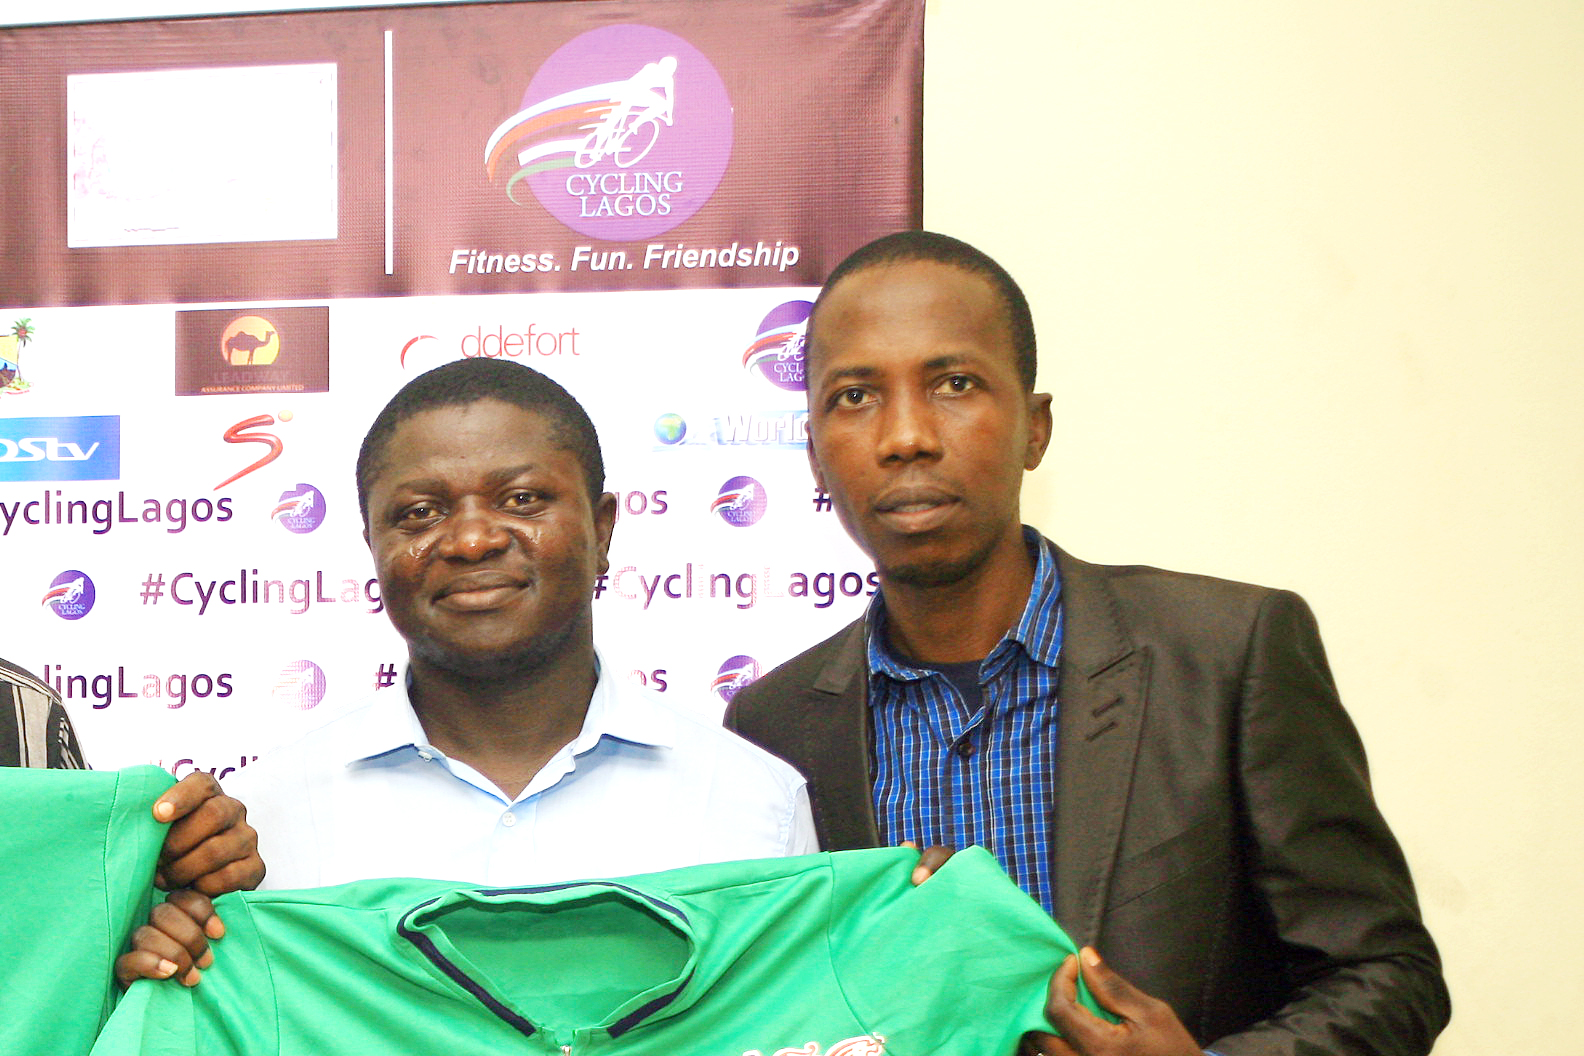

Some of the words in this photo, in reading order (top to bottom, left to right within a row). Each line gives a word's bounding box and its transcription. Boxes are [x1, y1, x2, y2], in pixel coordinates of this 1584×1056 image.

[566, 171, 683, 198] CYCLING
[580, 193, 672, 218] LAGOS
[449, 249, 561, 275] Fitness.
[571, 246, 634, 271] Fun.
[643, 241, 800, 272] Friendship
[780, 373, 804, 382] LAG
[139, 569, 384, 616] #CyclingLag
[44, 665, 234, 710] lingLagos
